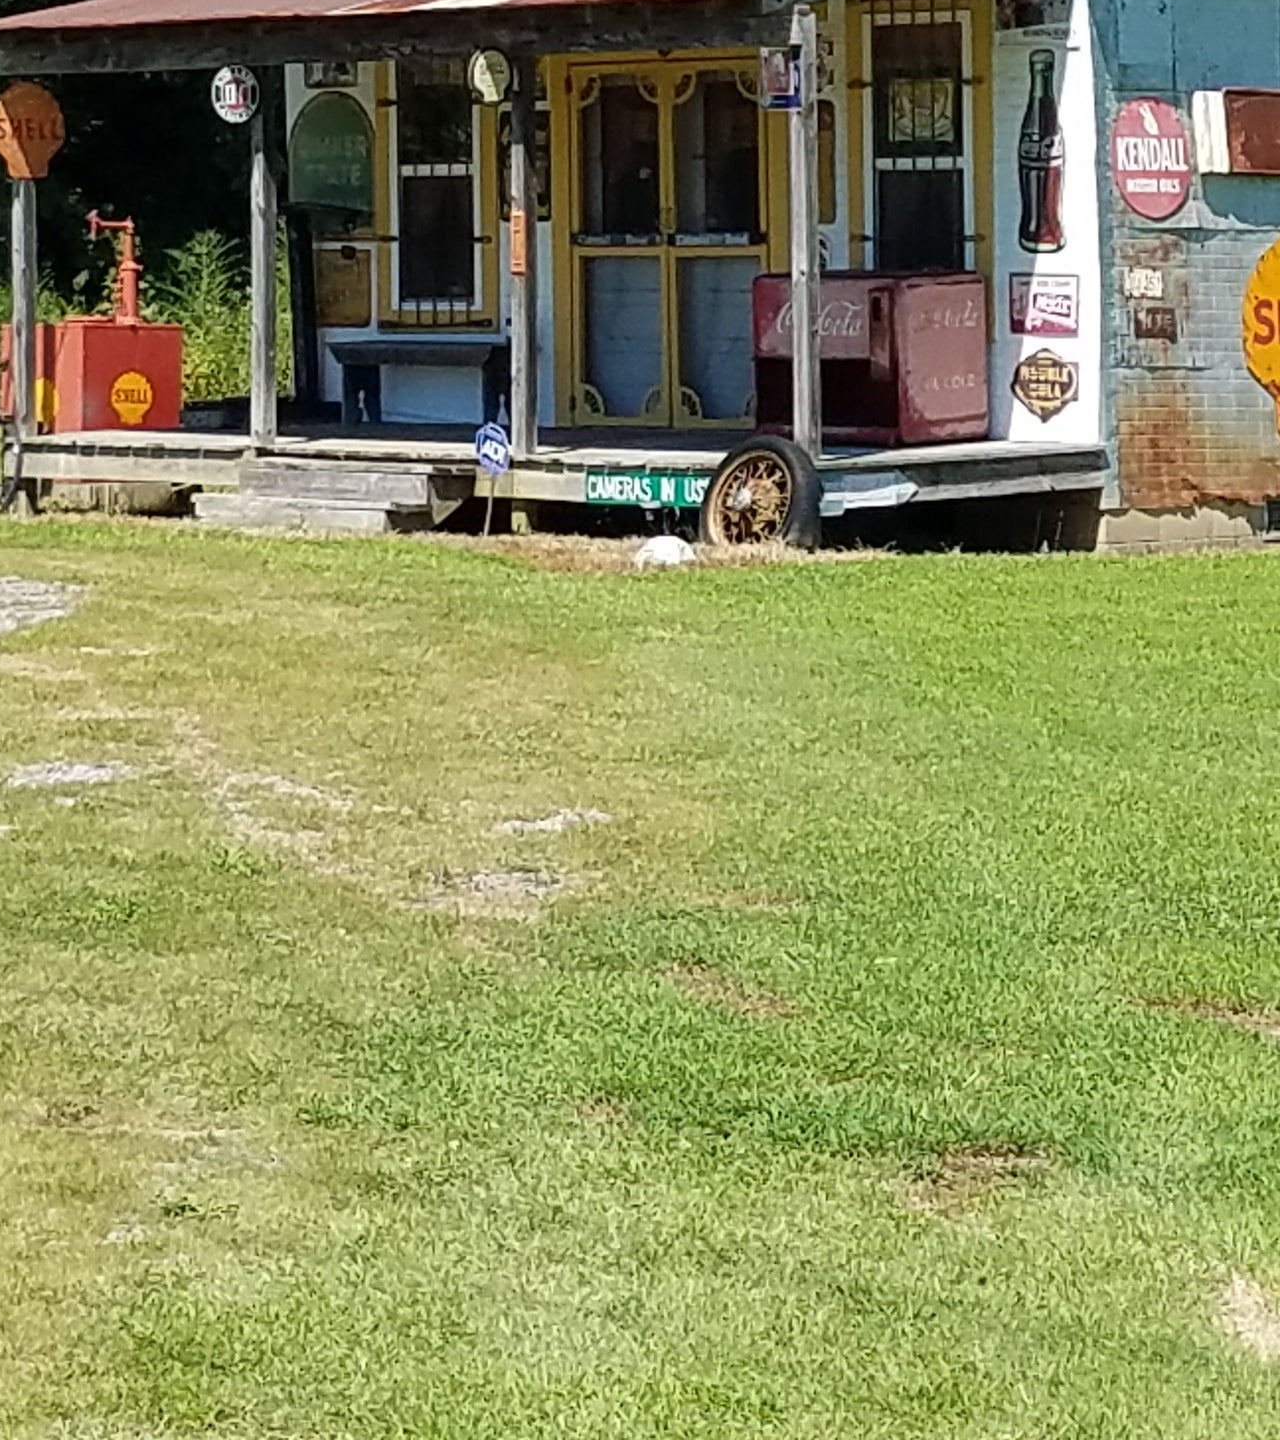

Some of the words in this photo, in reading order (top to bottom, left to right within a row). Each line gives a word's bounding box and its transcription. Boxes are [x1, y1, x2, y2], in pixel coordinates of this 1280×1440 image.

[1116, 136, 1189, 171] KENDALL
[114, 388, 148, 404] SHELL
[587, 475, 653, 501] CAMERAS
[660, 477, 677, 502] IN
